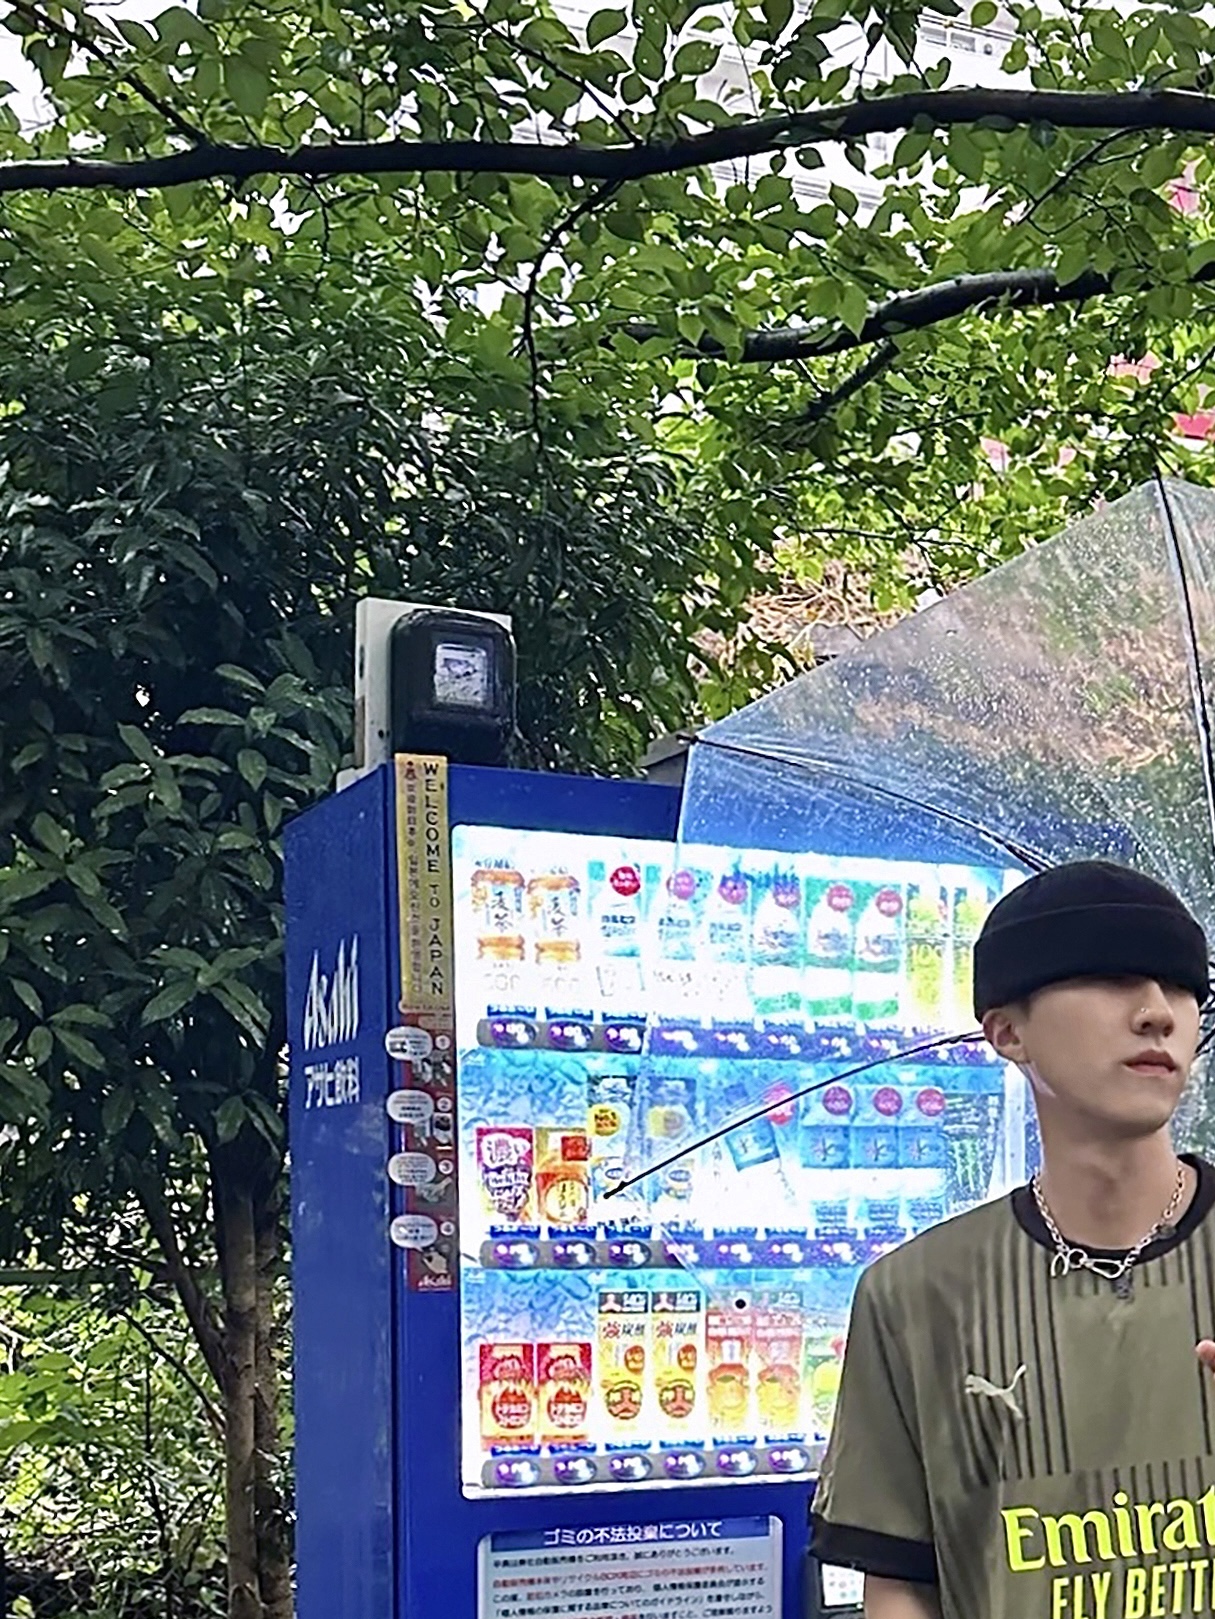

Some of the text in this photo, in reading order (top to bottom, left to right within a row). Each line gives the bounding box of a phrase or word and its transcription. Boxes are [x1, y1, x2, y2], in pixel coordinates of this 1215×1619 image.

[423, 761, 444, 995] WELCOME TO JAPAN
[304, 933, 359, 1051] Asahi
[304, 1056, 361, 1109] アサヒ飲料
